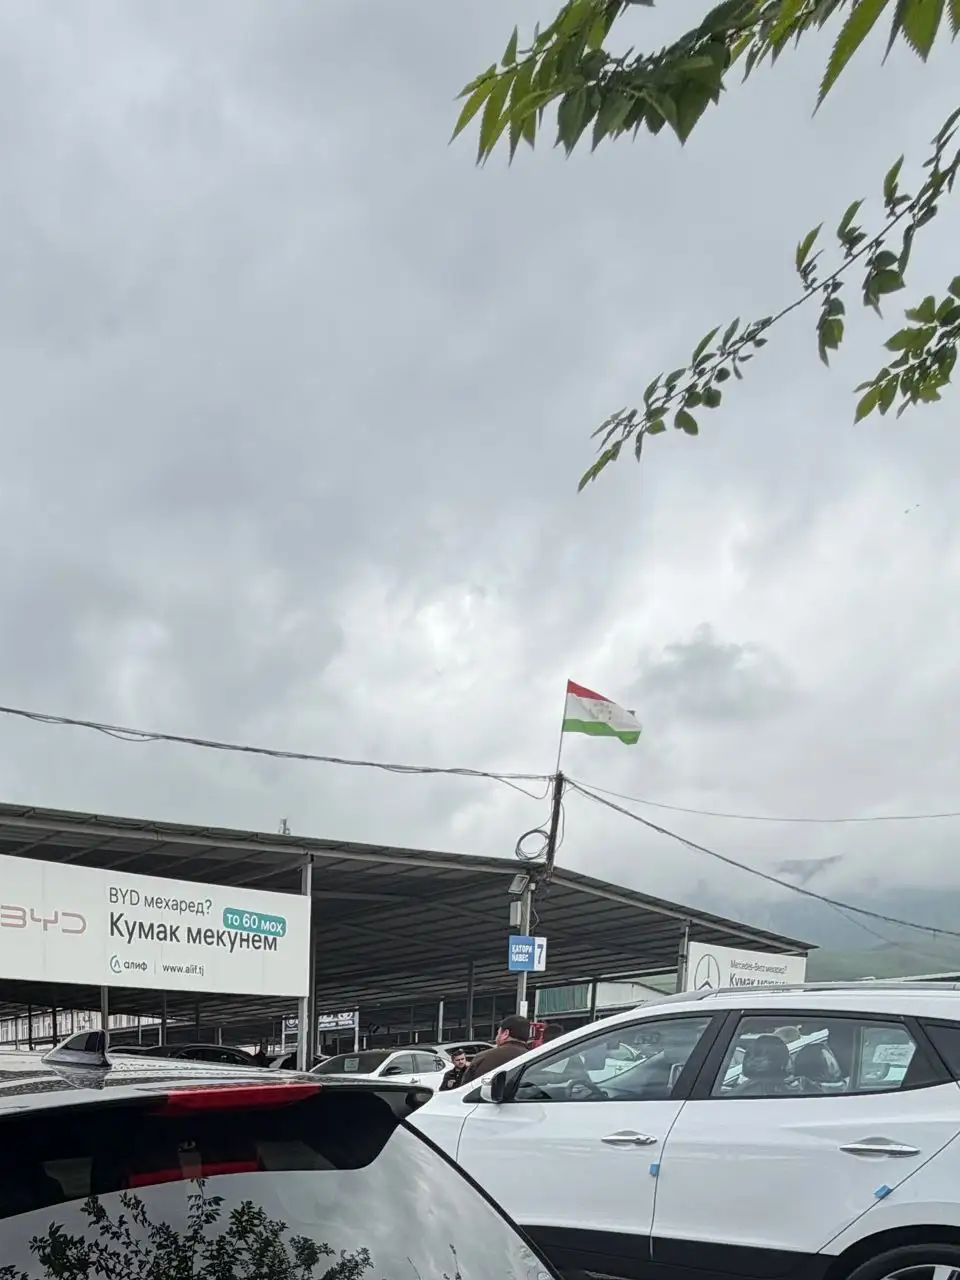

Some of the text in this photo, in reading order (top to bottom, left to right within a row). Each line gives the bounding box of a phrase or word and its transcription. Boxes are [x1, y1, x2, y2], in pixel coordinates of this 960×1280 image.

[109, 887, 212, 916] BYD мехаред?
[0, 904, 87, 935] BYD
[226, 913, 240, 926] то
[242, 913, 258, 928] 60
[110, 911, 278, 953] Кумак мекунем
[537, 943, 544, 965] 7
[123, 961, 148, 972] алиф
[162, 964, 204, 976] www.alif.tj
